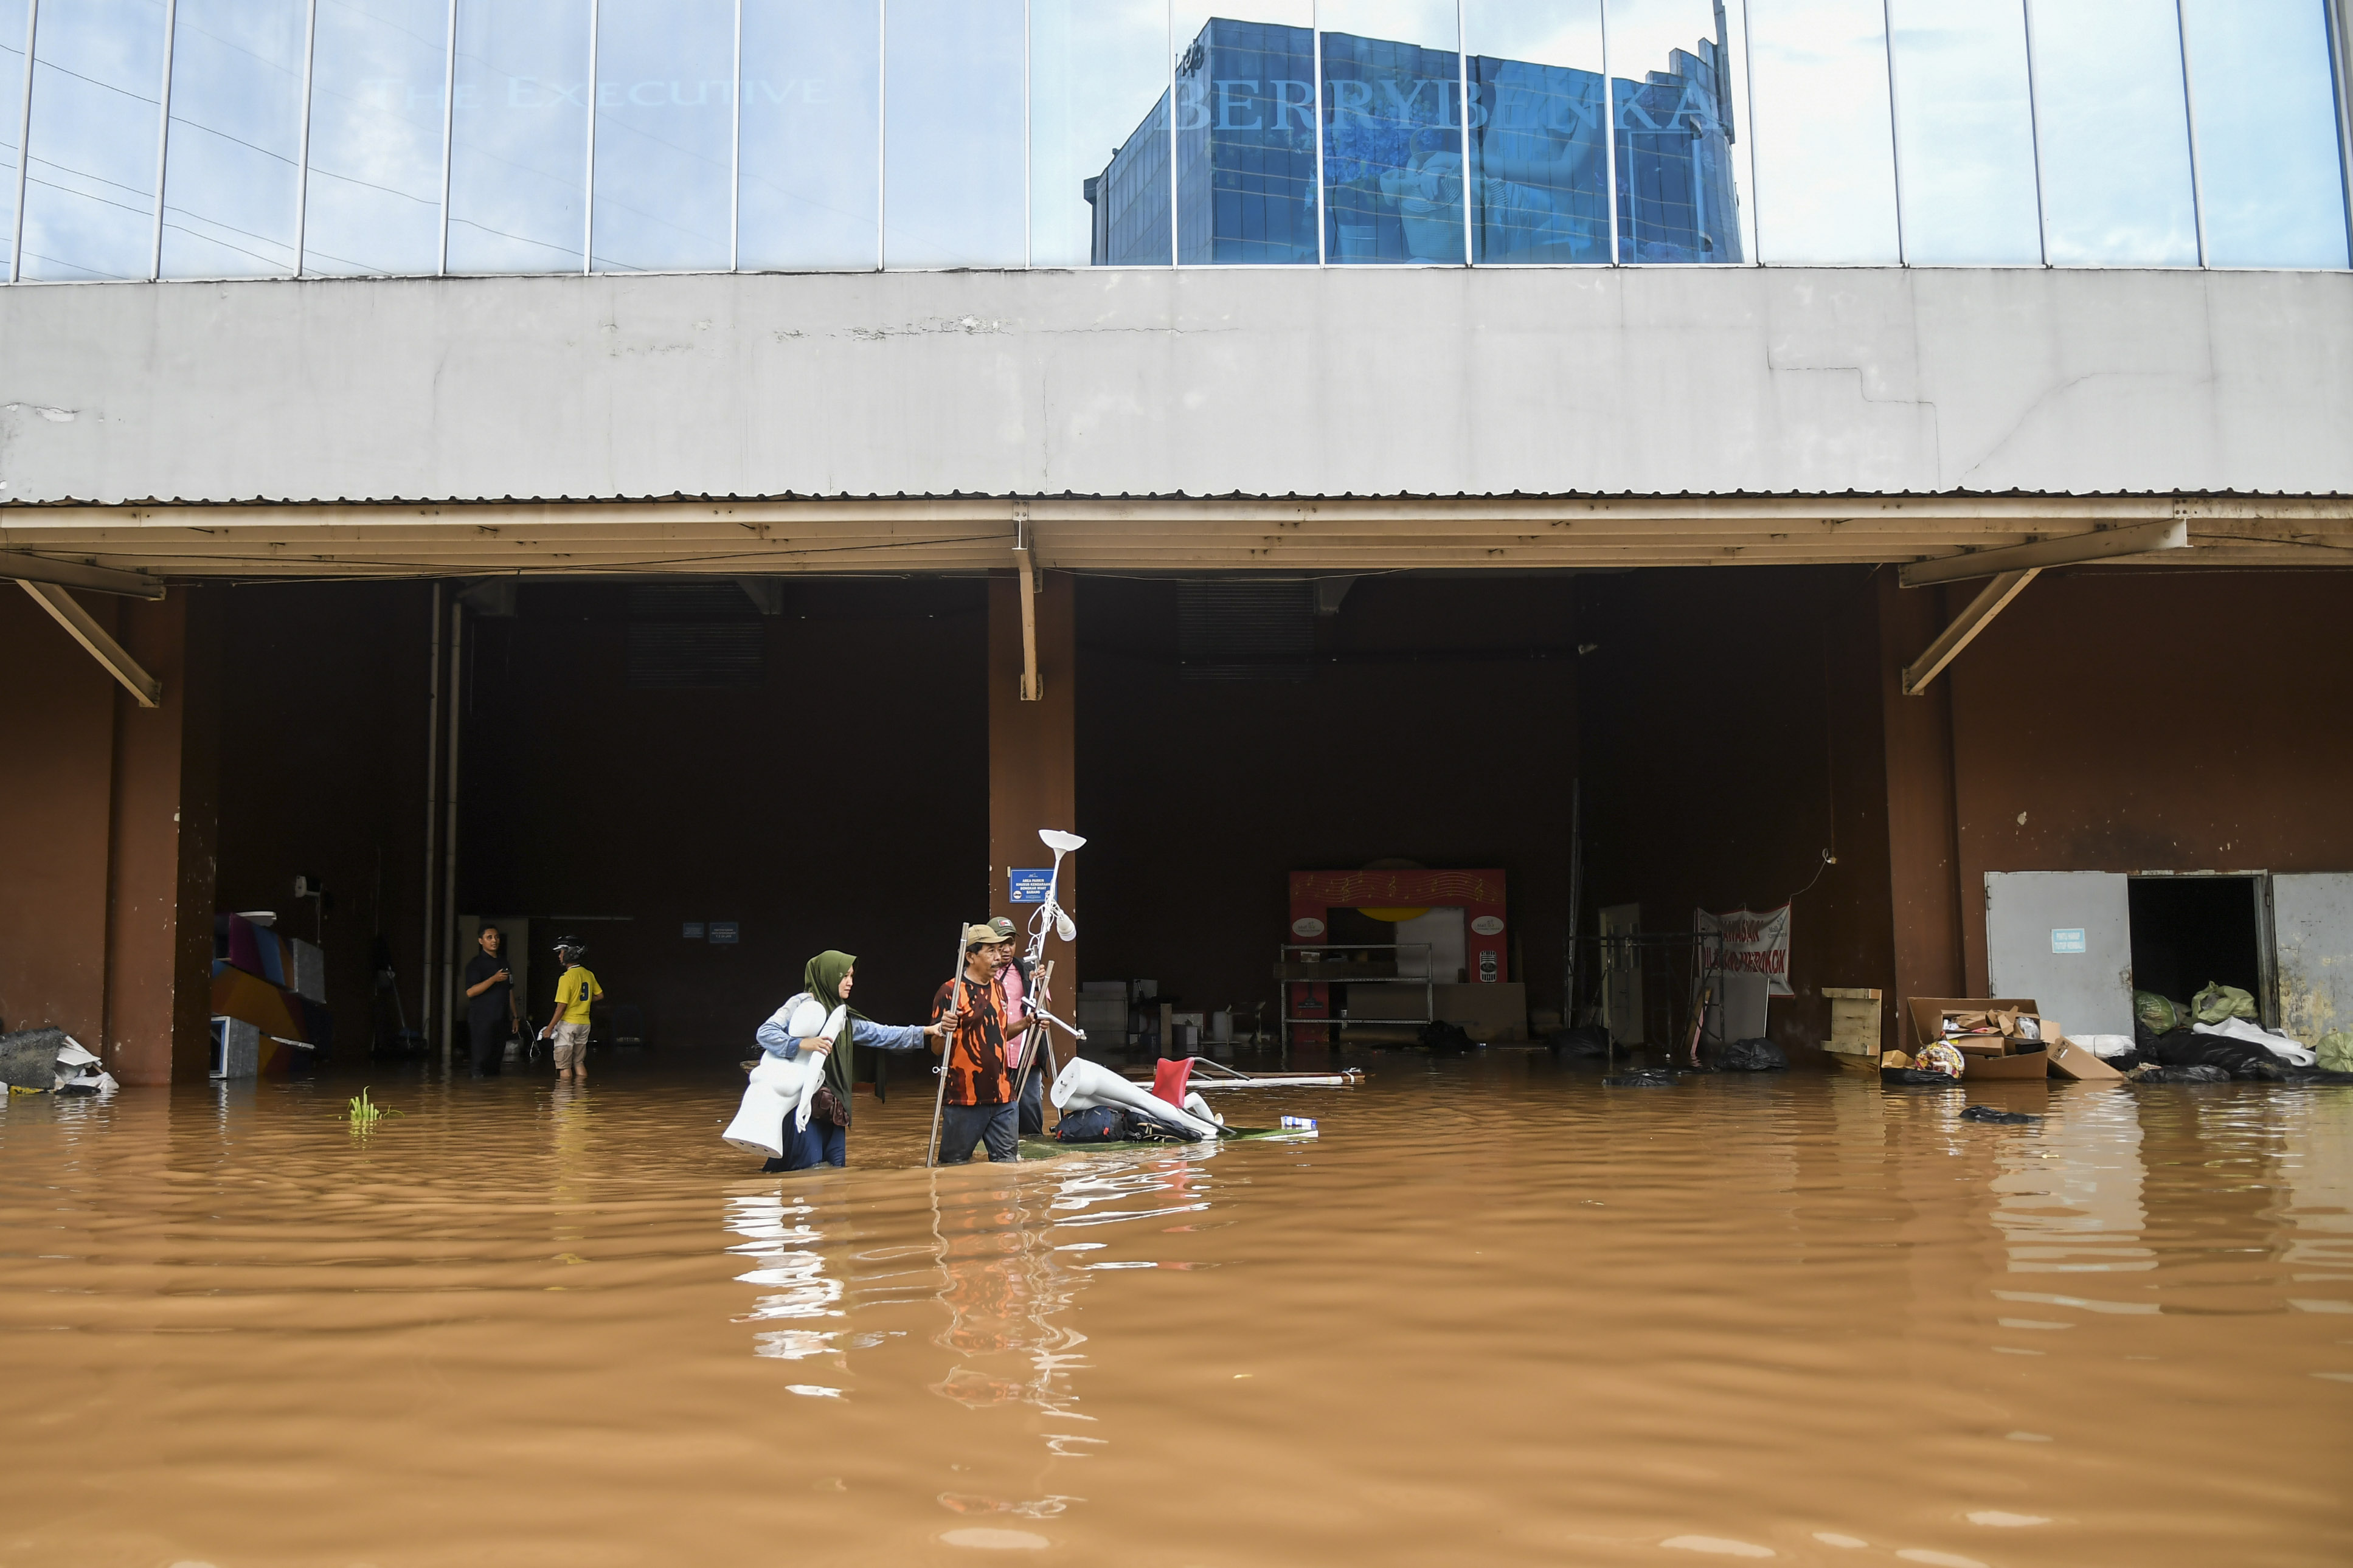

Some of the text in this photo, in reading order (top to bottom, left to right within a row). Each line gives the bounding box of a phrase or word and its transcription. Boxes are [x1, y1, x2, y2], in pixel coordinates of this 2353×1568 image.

[361, 74, 830, 111] THE EXECUTIVE
[1158, 78, 1722, 132] BERRYBENKA
[1720, 920, 1764, 942] AWASAN
[580, 982, 589, 1001] 9
